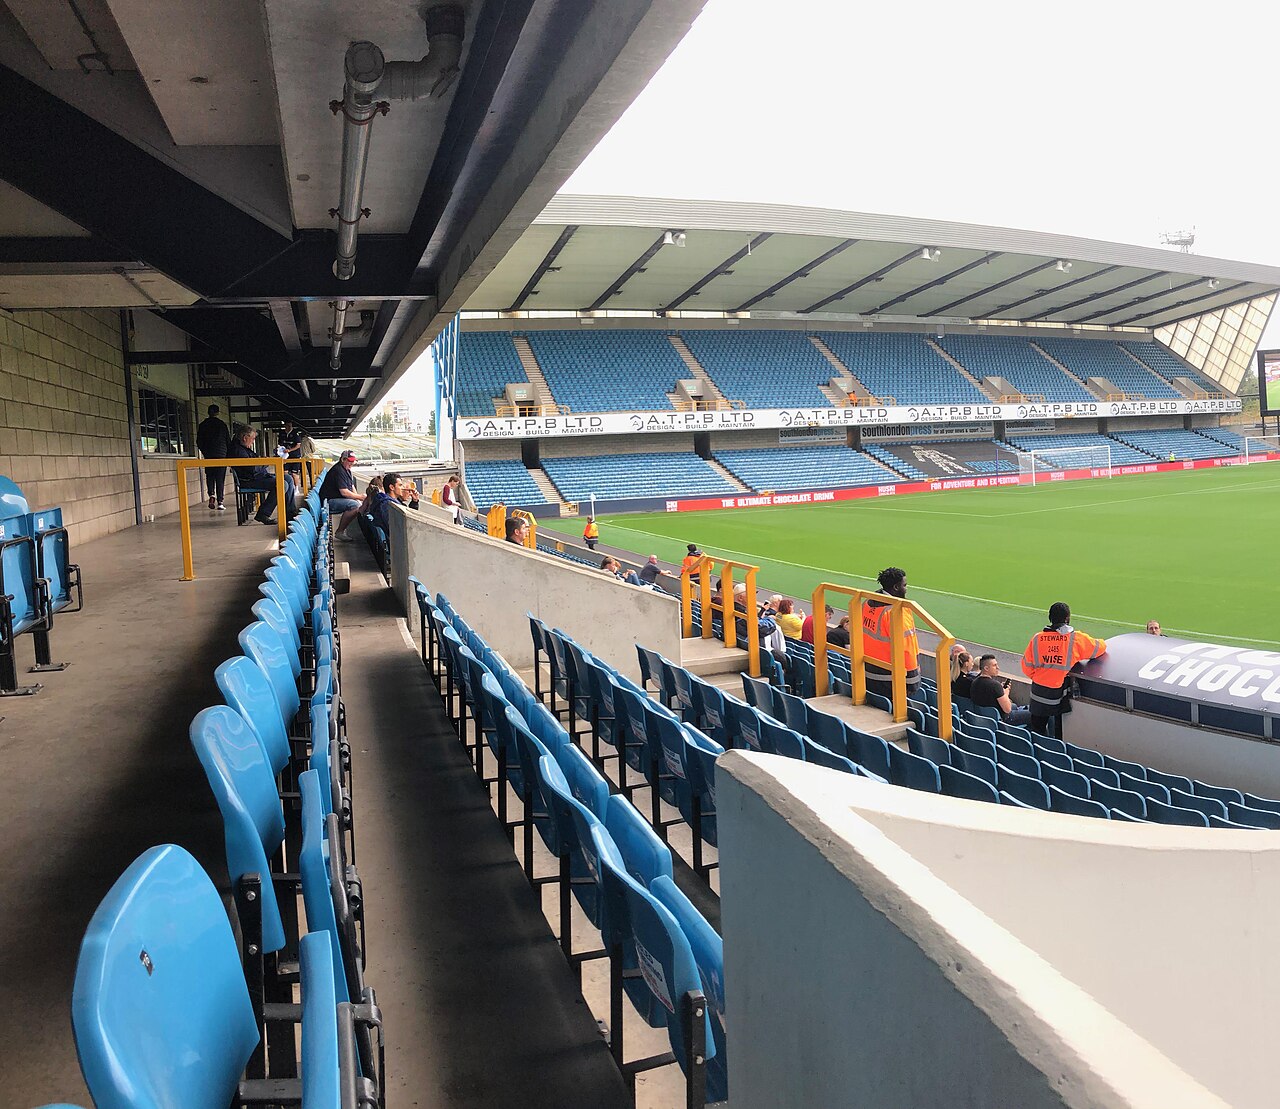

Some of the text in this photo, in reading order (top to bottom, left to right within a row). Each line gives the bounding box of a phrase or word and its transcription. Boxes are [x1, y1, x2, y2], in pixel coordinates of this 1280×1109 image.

[921, 406, 1002, 416] A.T.P.B LTD
[1029, 404, 1098, 413] A.T.P.B LTD
[1120, 402, 1178, 411] A.T.P.B LTD
[647, 412, 754, 425] A.T.P.B LTD
[794, 408, 888, 420] A.T.P.B LTD
[483, 416, 602, 431] A.T.P.B LTD
[861, 423, 933, 438] southlondonpress
[878, 485, 896, 493] HUSKI
[930, 476, 1020, 491] FOR ADVENTURE AND EXPEDITION
[722, 491, 835, 508] THE ULTIMATE CHOCOLATE DRINK
[1042, 655, 1063, 664] WISE
